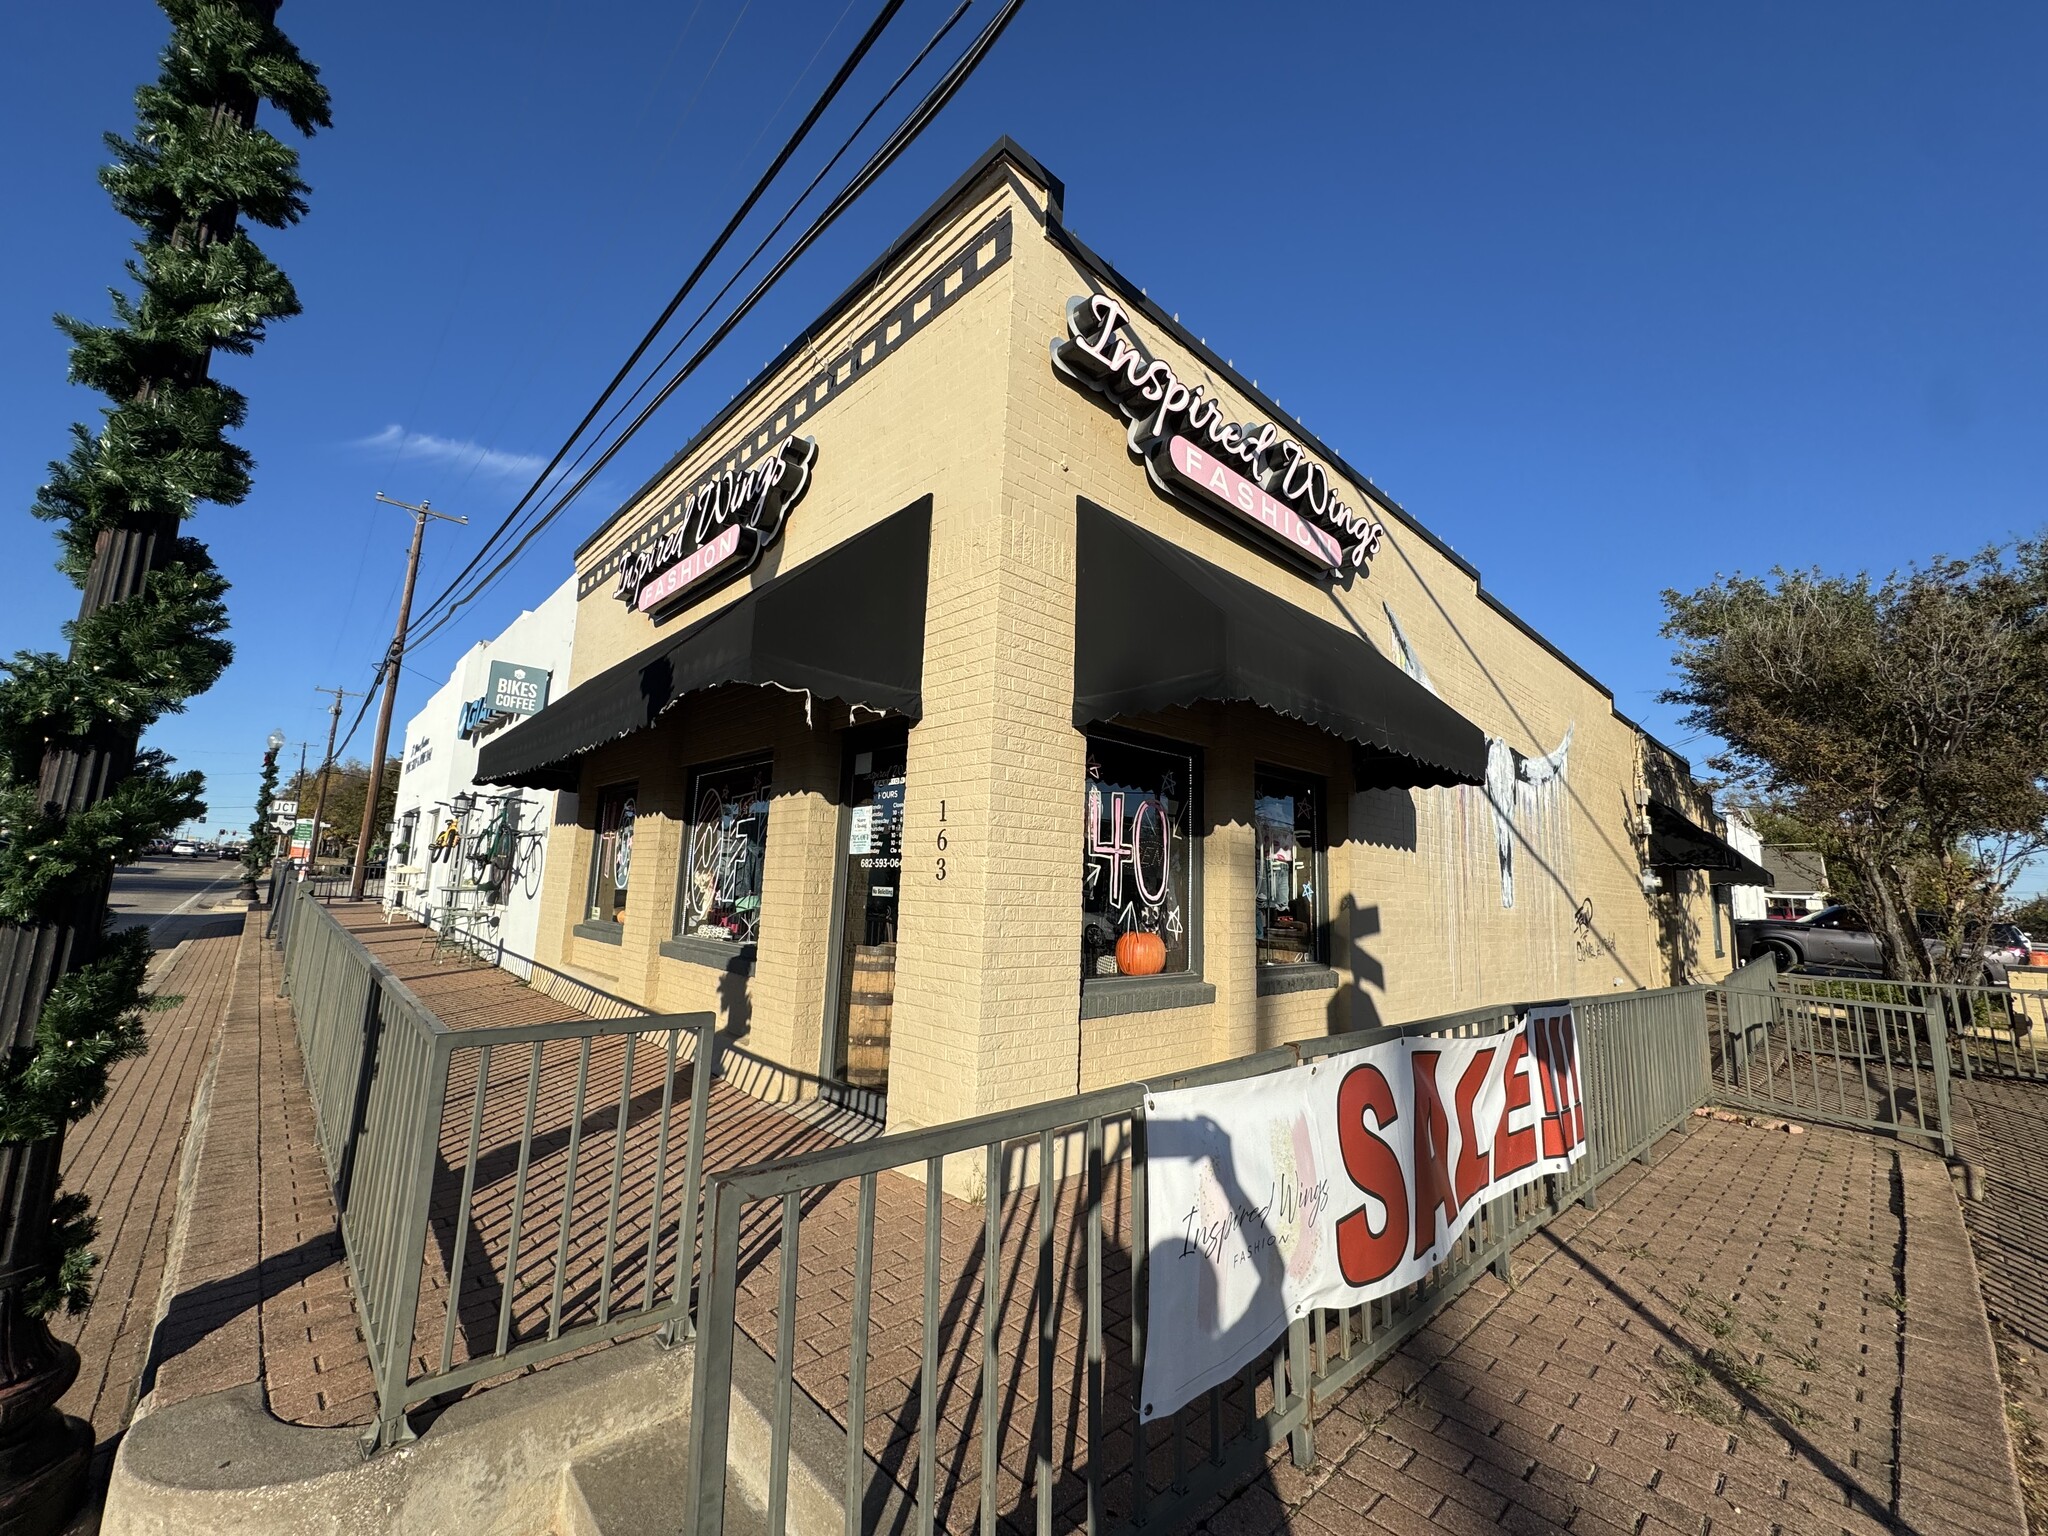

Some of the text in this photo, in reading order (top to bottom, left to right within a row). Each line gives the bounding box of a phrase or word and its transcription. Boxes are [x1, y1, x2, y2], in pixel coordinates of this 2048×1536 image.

[1076, 293, 1384, 567] Inspired Wings
[613, 435, 793, 604] Inspired Wings
[1186, 446, 1332, 556] FASHION
[644, 531, 732, 606] FASHION
[495, 693, 536, 711] COFFEE
[497, 678, 538, 699] BIKES
[275, 803, 296, 812] JCT
[1088, 791, 1170, 909] 40
[1335, 1013, 1585, 1288] SALE!!!
[1178, 1170, 1331, 1264] Inspired Wings
[1233, 1235, 1290, 1267] FASHION
